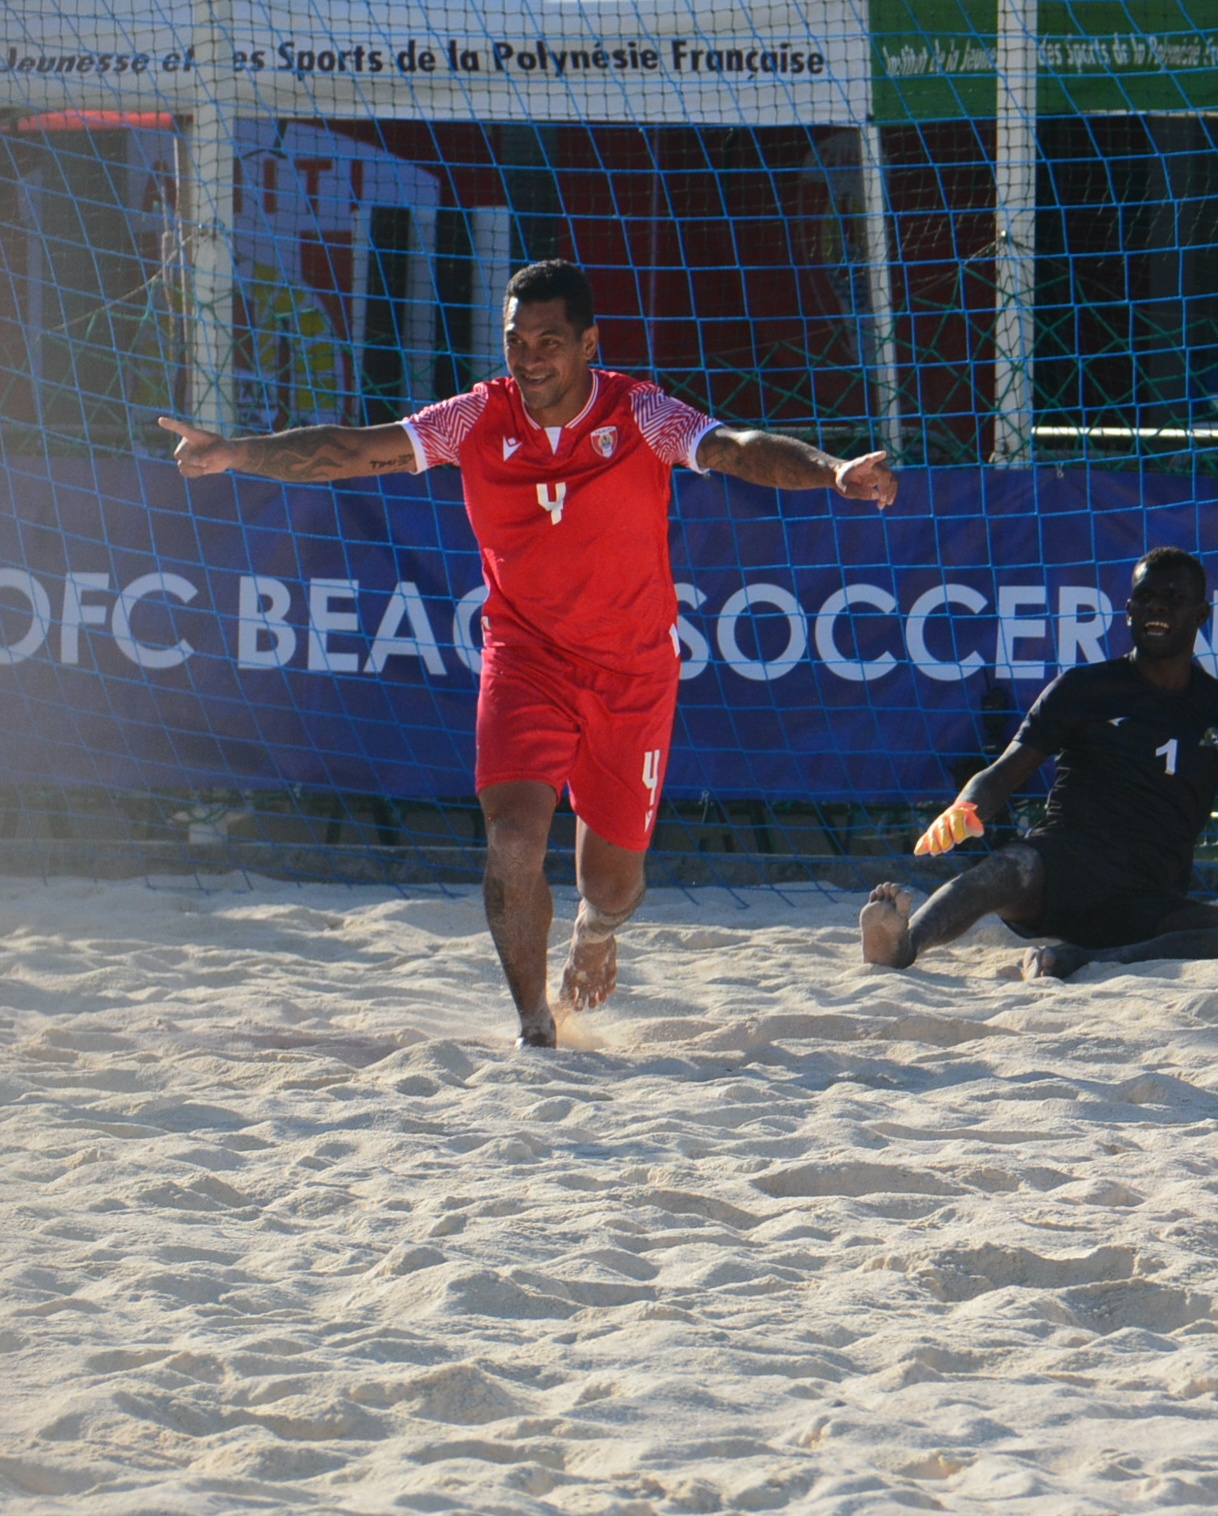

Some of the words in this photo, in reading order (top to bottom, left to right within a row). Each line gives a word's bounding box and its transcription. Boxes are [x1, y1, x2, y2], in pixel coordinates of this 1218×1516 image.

[0, 46, 150, 73] Jeunesse
[233, 50, 266, 73] es
[277, 41, 384, 81] Sports
[396, 39, 437, 73] de
[449, 39, 480, 72] la
[493, 40, 660, 78] Polynésie
[671, 40, 826, 80] Française
[143, 157, 364, 214] AITI
[536, 482, 566, 525] 4
[0, 568, 199, 670] OFC
[238, 575, 490, 676] BEAC
[642, 750, 660, 806] 4
[1155, 738, 1178, 775] 1
